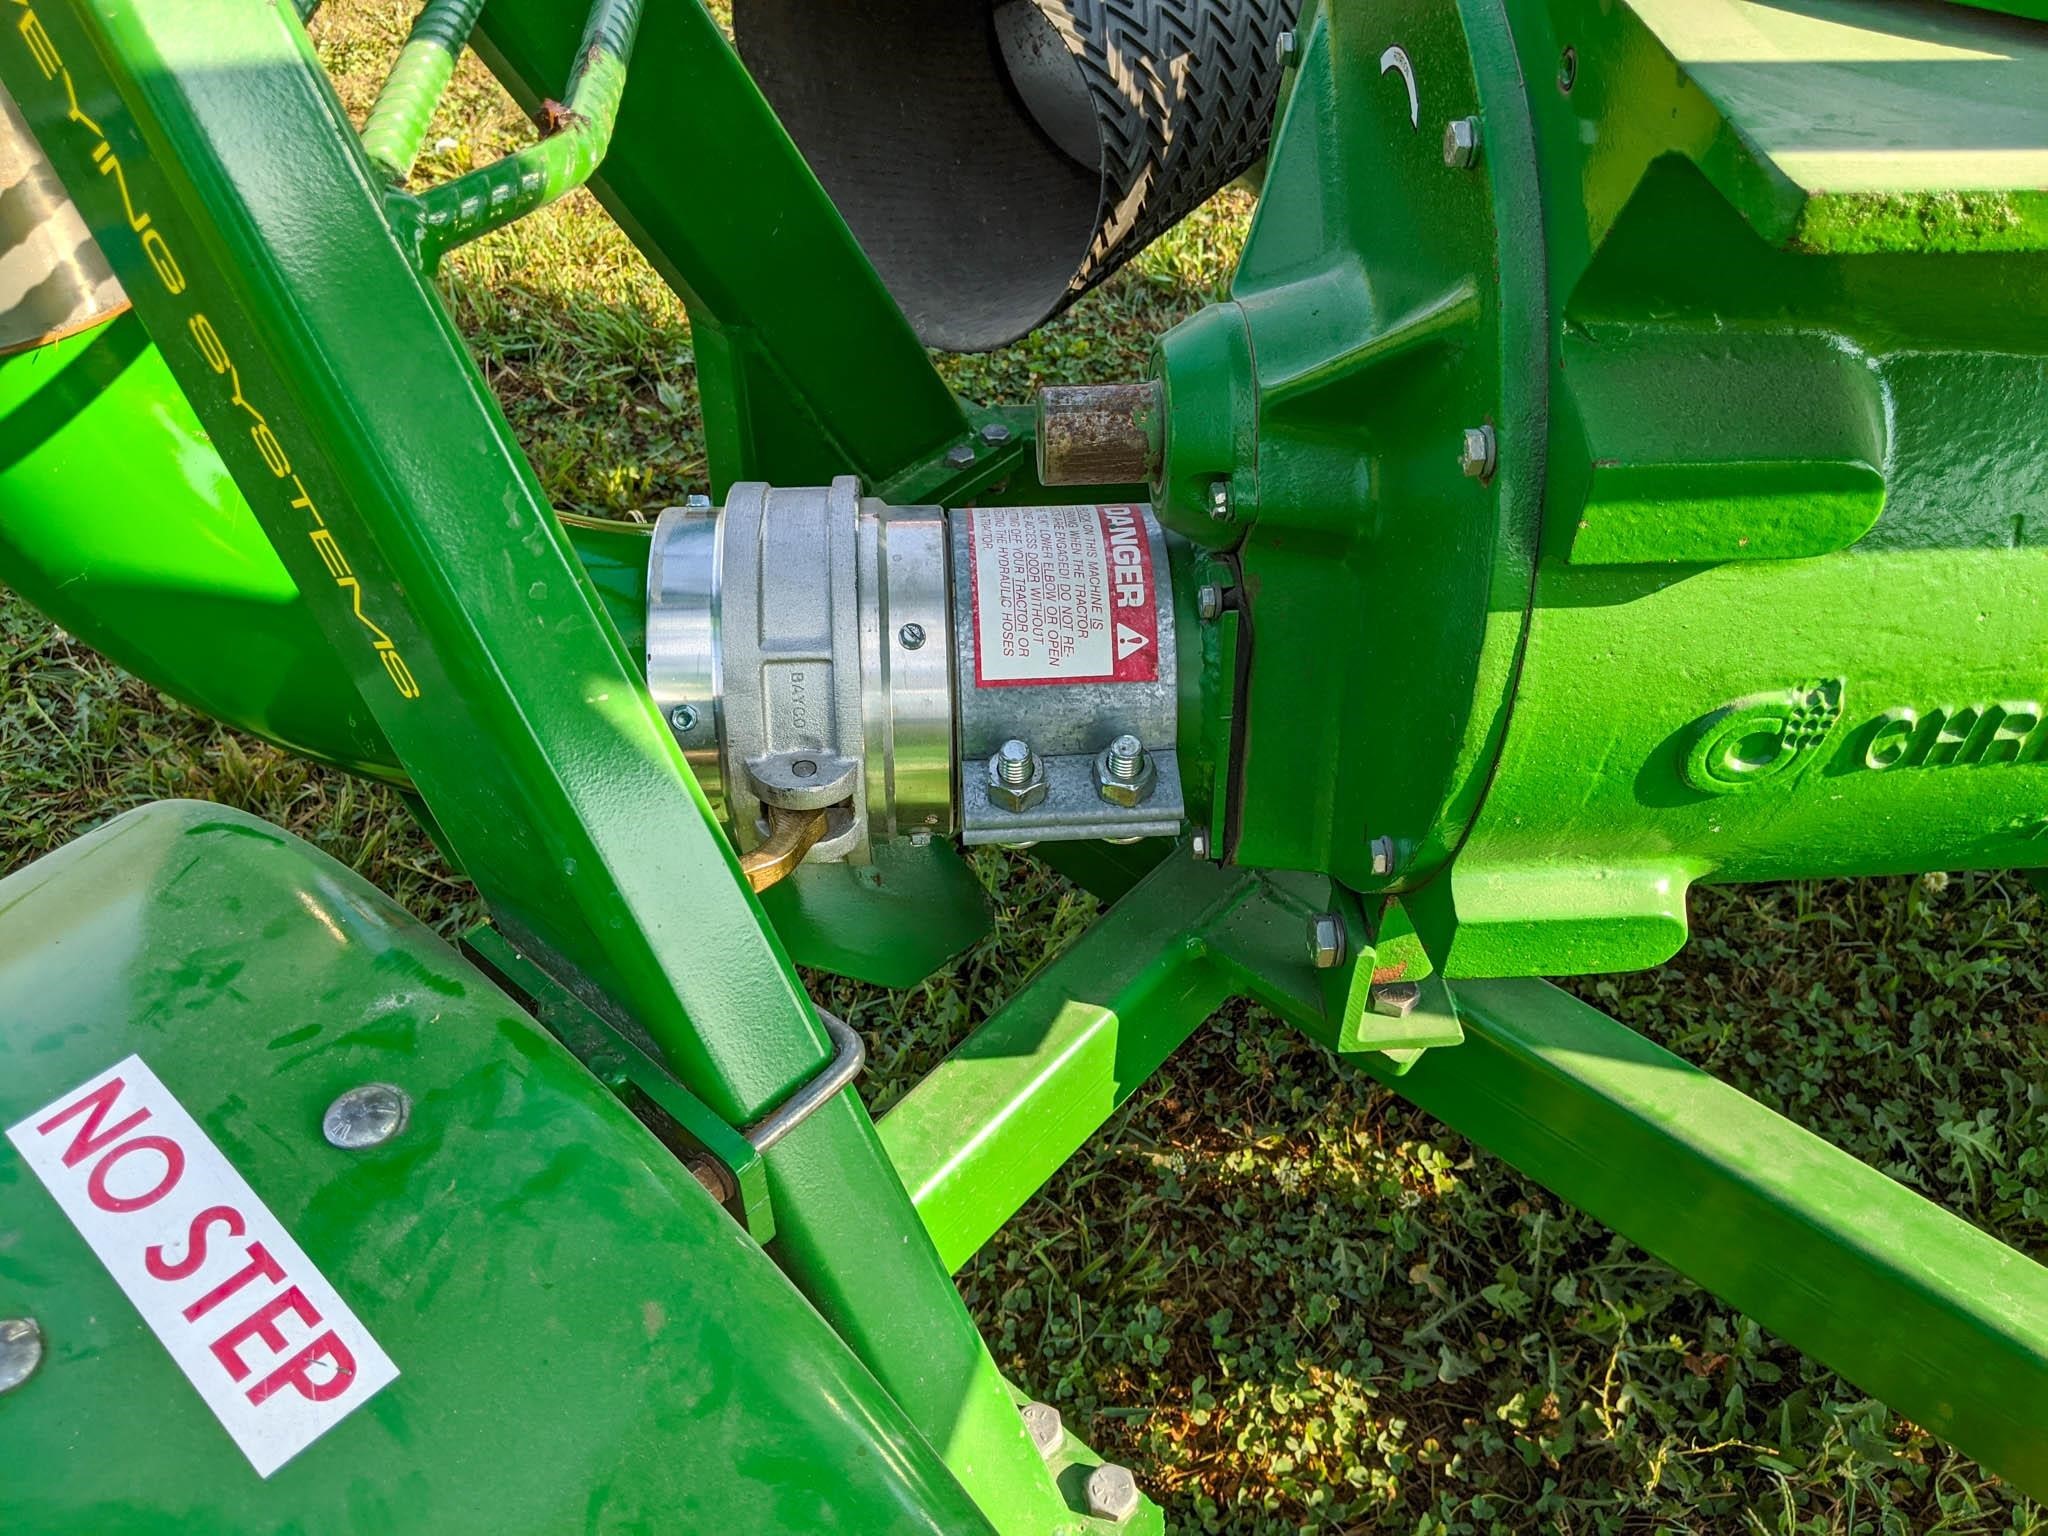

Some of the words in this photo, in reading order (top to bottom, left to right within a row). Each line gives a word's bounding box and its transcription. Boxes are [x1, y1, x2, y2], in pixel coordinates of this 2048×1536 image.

[9, 0, 187, 296] EYING
[188, 312, 420, 700] SYSTEMS
[995, 529, 1008, 544] THE
[1010, 528, 1023, 545] OFF
[1024, 520, 1038, 550] ACCESS
[1069, 530, 1082, 555] WHEN
[1082, 524, 1095, 535] ON
[1040, 530, 1053, 559] LOWER
[1086, 537, 1098, 558] THIS
[1104, 506, 1146, 609] DANGER
[1012, 547, 1025, 574] YOUR
[1027, 552, 1041, 583] DOOR
[1072, 559, 1085, 579] THE
[998, 547, 1012, 608] HYDRAULIC
[1043, 562, 1057, 602] ELBOW
[1088, 560, 1103, 614] MACHINE
[1015, 578, 1029, 633] TRACTOR
[1059, 583, 1072, 602] DO
[1030, 588, 1044, 645] WITHOUT
[1046, 606, 1058, 625] OR
[1061, 605, 1074, 632] NOT
[1074, 583, 1089, 639] TRACTOR
[1091, 618, 1104, 631] IS
[1002, 612, 1015, 657] HOSES
[1018, 637, 1030, 657] OR
[1048, 630, 1060, 667] OPEN
[1062, 635, 1075, 657] RE-
[791, 672, 806, 728] BAYCO
[36, 1076, 186, 1213] NO
[145, 1205, 358, 1407] STEP
